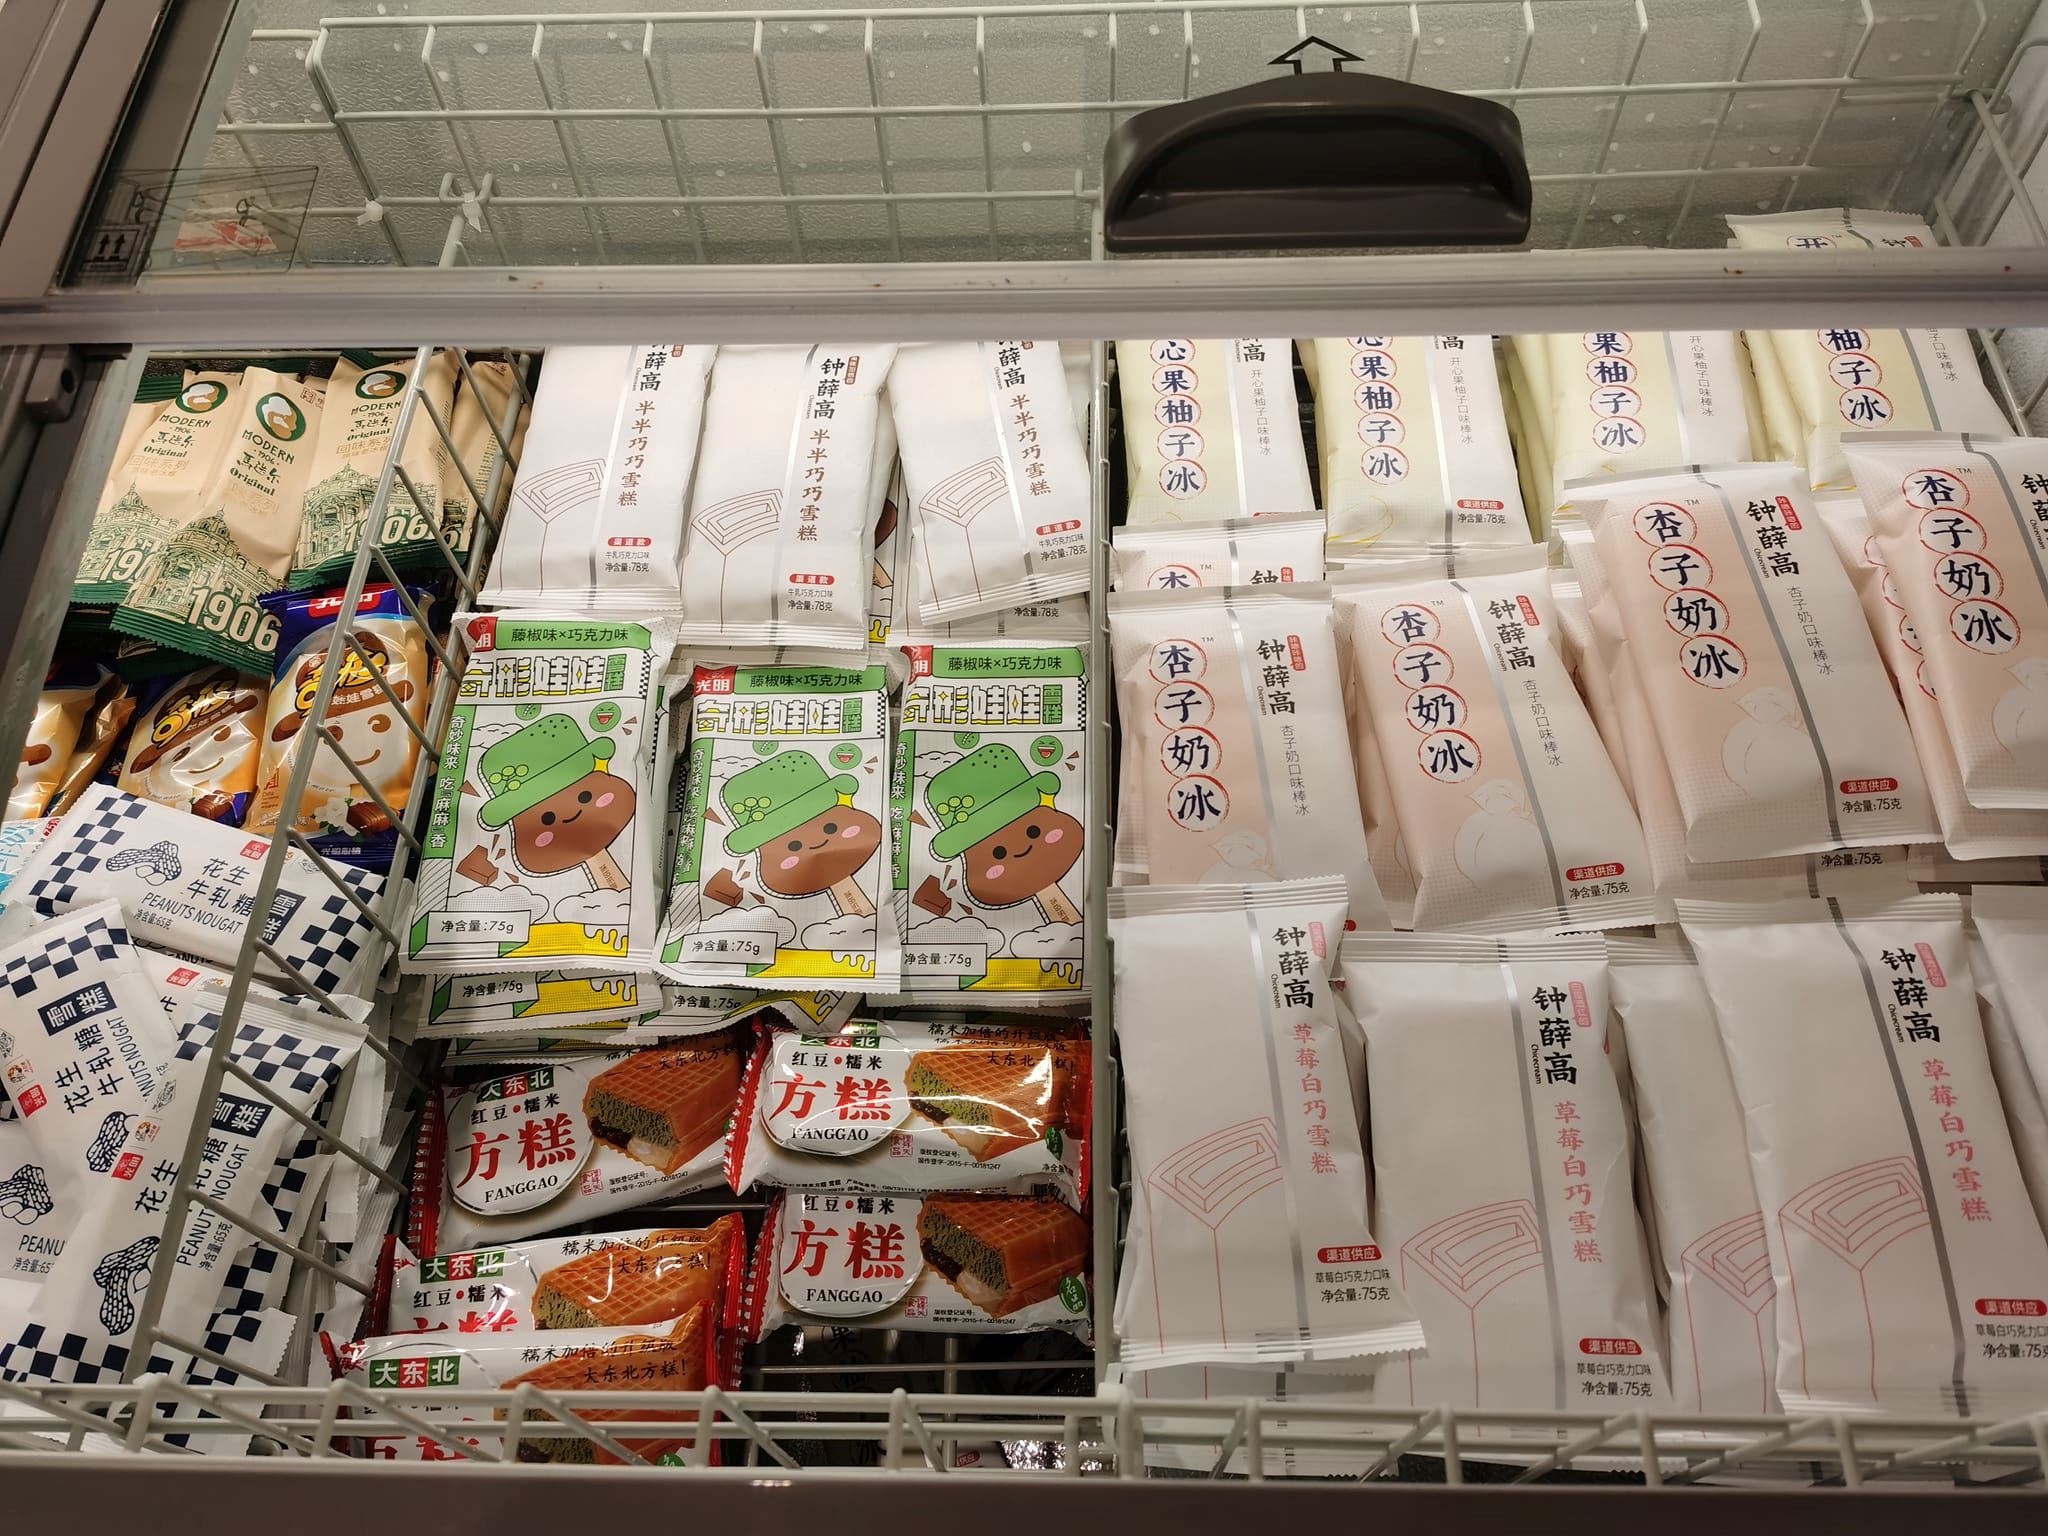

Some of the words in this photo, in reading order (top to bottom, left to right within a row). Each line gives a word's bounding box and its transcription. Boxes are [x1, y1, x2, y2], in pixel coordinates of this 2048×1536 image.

[639, 344, 667, 392] 薛高
[996, 338, 1026, 388] 薛高
[1690, 335, 1715, 417] 开心果柚子口味棒冰
[1827, 329, 1888, 422] 柚子冰
[351, 401, 401, 416] MODERN
[813, 358, 846, 419] 钟薛高
[1449, 356, 1474, 445] 开心果柚子口味棒冰
[1592, 332, 1640, 447] 果柚子冰
[159, 414, 212, 429] MODERN
[1158, 340, 1201, 493] 心果柚子冰
[1250, 368, 1272, 456] 开心果柚子口味棒冰
[143, 445, 188, 458] Original
[241, 429, 295, 465] MODERN
[347, 428, 391, 442] Original
[616, 400, 656, 507] 半半巧巧雪糕
[1009, 393, 1052, 496] 半半巧巧雪糕
[229, 467, 276, 496] Original
[796, 428, 831, 542] 半半巧巧雪糕
[1457, 512, 1507, 525] 净含量:78克
[1745, 499, 1800, 578] 钟薛高
[605, 561, 649, 573] 净含量:78克
[1040, 544, 1088, 561] 净含量:78克
[1915, 476, 2014, 645] 杏子奶冰
[788, 599, 833, 612] 净含量:78克
[1014, 607, 1060, 618] 净含量:78克
[1645, 509, 1740, 680] 杏子奶冰
[187, 585, 284, 653] 1906
[510, 627, 629, 643] 藤椒味×巧克力味
[1487, 599, 1536, 671] 钟薛高
[1787, 586, 1834, 675] 杏子奶口味棒冰
[459, 654, 605, 698] 奇形娃娃
[605, 653, 627, 692] 雪糕
[749, 672, 864, 689] 藤椒味×巧克力味
[947, 655, 1063, 672] 藤椒味×巧克力味
[1256, 638, 1297, 715] 钟薛高
[696, 678, 730, 693] 光明
[903, 685, 1042, 725] 奇形娃娃
[1042, 684, 1063, 725] 雪糕
[1391, 609, 1474, 775] 杏子奶冰
[696, 698, 842, 735] 奇形娃娃
[842, 697, 863, 733] 雪糕
[1159, 645, 1221, 822] 杏子奶冰
[1523, 679, 1563, 766] 杏子奶口味棒冰
[443, 715, 467, 770] 奇妙味来
[1280, 725, 1311, 816] 杏子奶口味棒冰
[1846, 779, 1891, 792] 渠道供应
[1842, 797, 1902, 814] 净含量:75克
[201, 857, 251, 887] 花生
[1573, 864, 1618, 880] 渠道供应
[1820, 852, 1883, 867] 净含量:75克
[187, 879, 257, 918] 牛轧糖
[1569, 881, 1630, 900] 净含量:75克
[132, 907, 175, 931] 净含量:65克
[141, 891, 198, 920] PEANUTS
[192, 907, 245, 935] NOUGAT
[440, 918, 514, 935] 净含量:75g
[692, 939, 760, 954] 净含量:75g
[904, 952, 973, 968] 净含量:75g
[1272, 926, 1315, 1009] 钟薛高
[46, 986, 109, 1029] 雪糕
[462, 980, 524, 998] 净含量:75g
[1880, 947, 1941, 1044] 钟薛高
[105, 1016, 142, 1062] NOUGAT
[1531, 985, 1578, 1085] 钟薛高
[73, 1023, 125, 1096] 牛轧糖
[54, 1061, 95, 1114] 花生
[482, 1068, 552, 1100] 大东北
[768, 1072, 894, 1122] 方糕
[1291, 1022, 1338, 1176] 草莓白巧雪糕
[456, 1112, 578, 1190] 方糕
[791, 1127, 869, 1142] FANGGAO
[1921, 1058, 1992, 1222] 草莓白巧雪糕
[134, 1158, 182, 1214] 花生
[483, 1174, 560, 1204] FANGGAO
[1553, 1100, 1603, 1263] 草莓白巧雪糕
[175, 1206, 216, 1266] PEANUT
[209, 1143, 251, 1201] NOUGAT
[11, 1256, 56, 1274] 净含量:65
[19, 1233, 67, 1257] PEANU
[198, 1221, 234, 1272] 净含量:65克
[782, 1219, 906, 1280] 方糕
[1325, 1246, 1378, 1262] 渠道供应
[424, 1253, 504, 1281] 大东北
[1315, 1269, 1392, 1285] 草莓白巧克力口味
[806, 1289, 883, 1303] FANGGAO
[1320, 1285, 1391, 1304] 净含量:75克
[1983, 1300, 2040, 1316] 渠道供应
[1588, 1339, 1639, 1355] 渠道供应
[373, 1357, 456, 1387] 大东北
[1576, 1362, 1652, 1378] 草莓白巧克力口味
[1581, 1380, 1653, 1398] 净含量:75克
